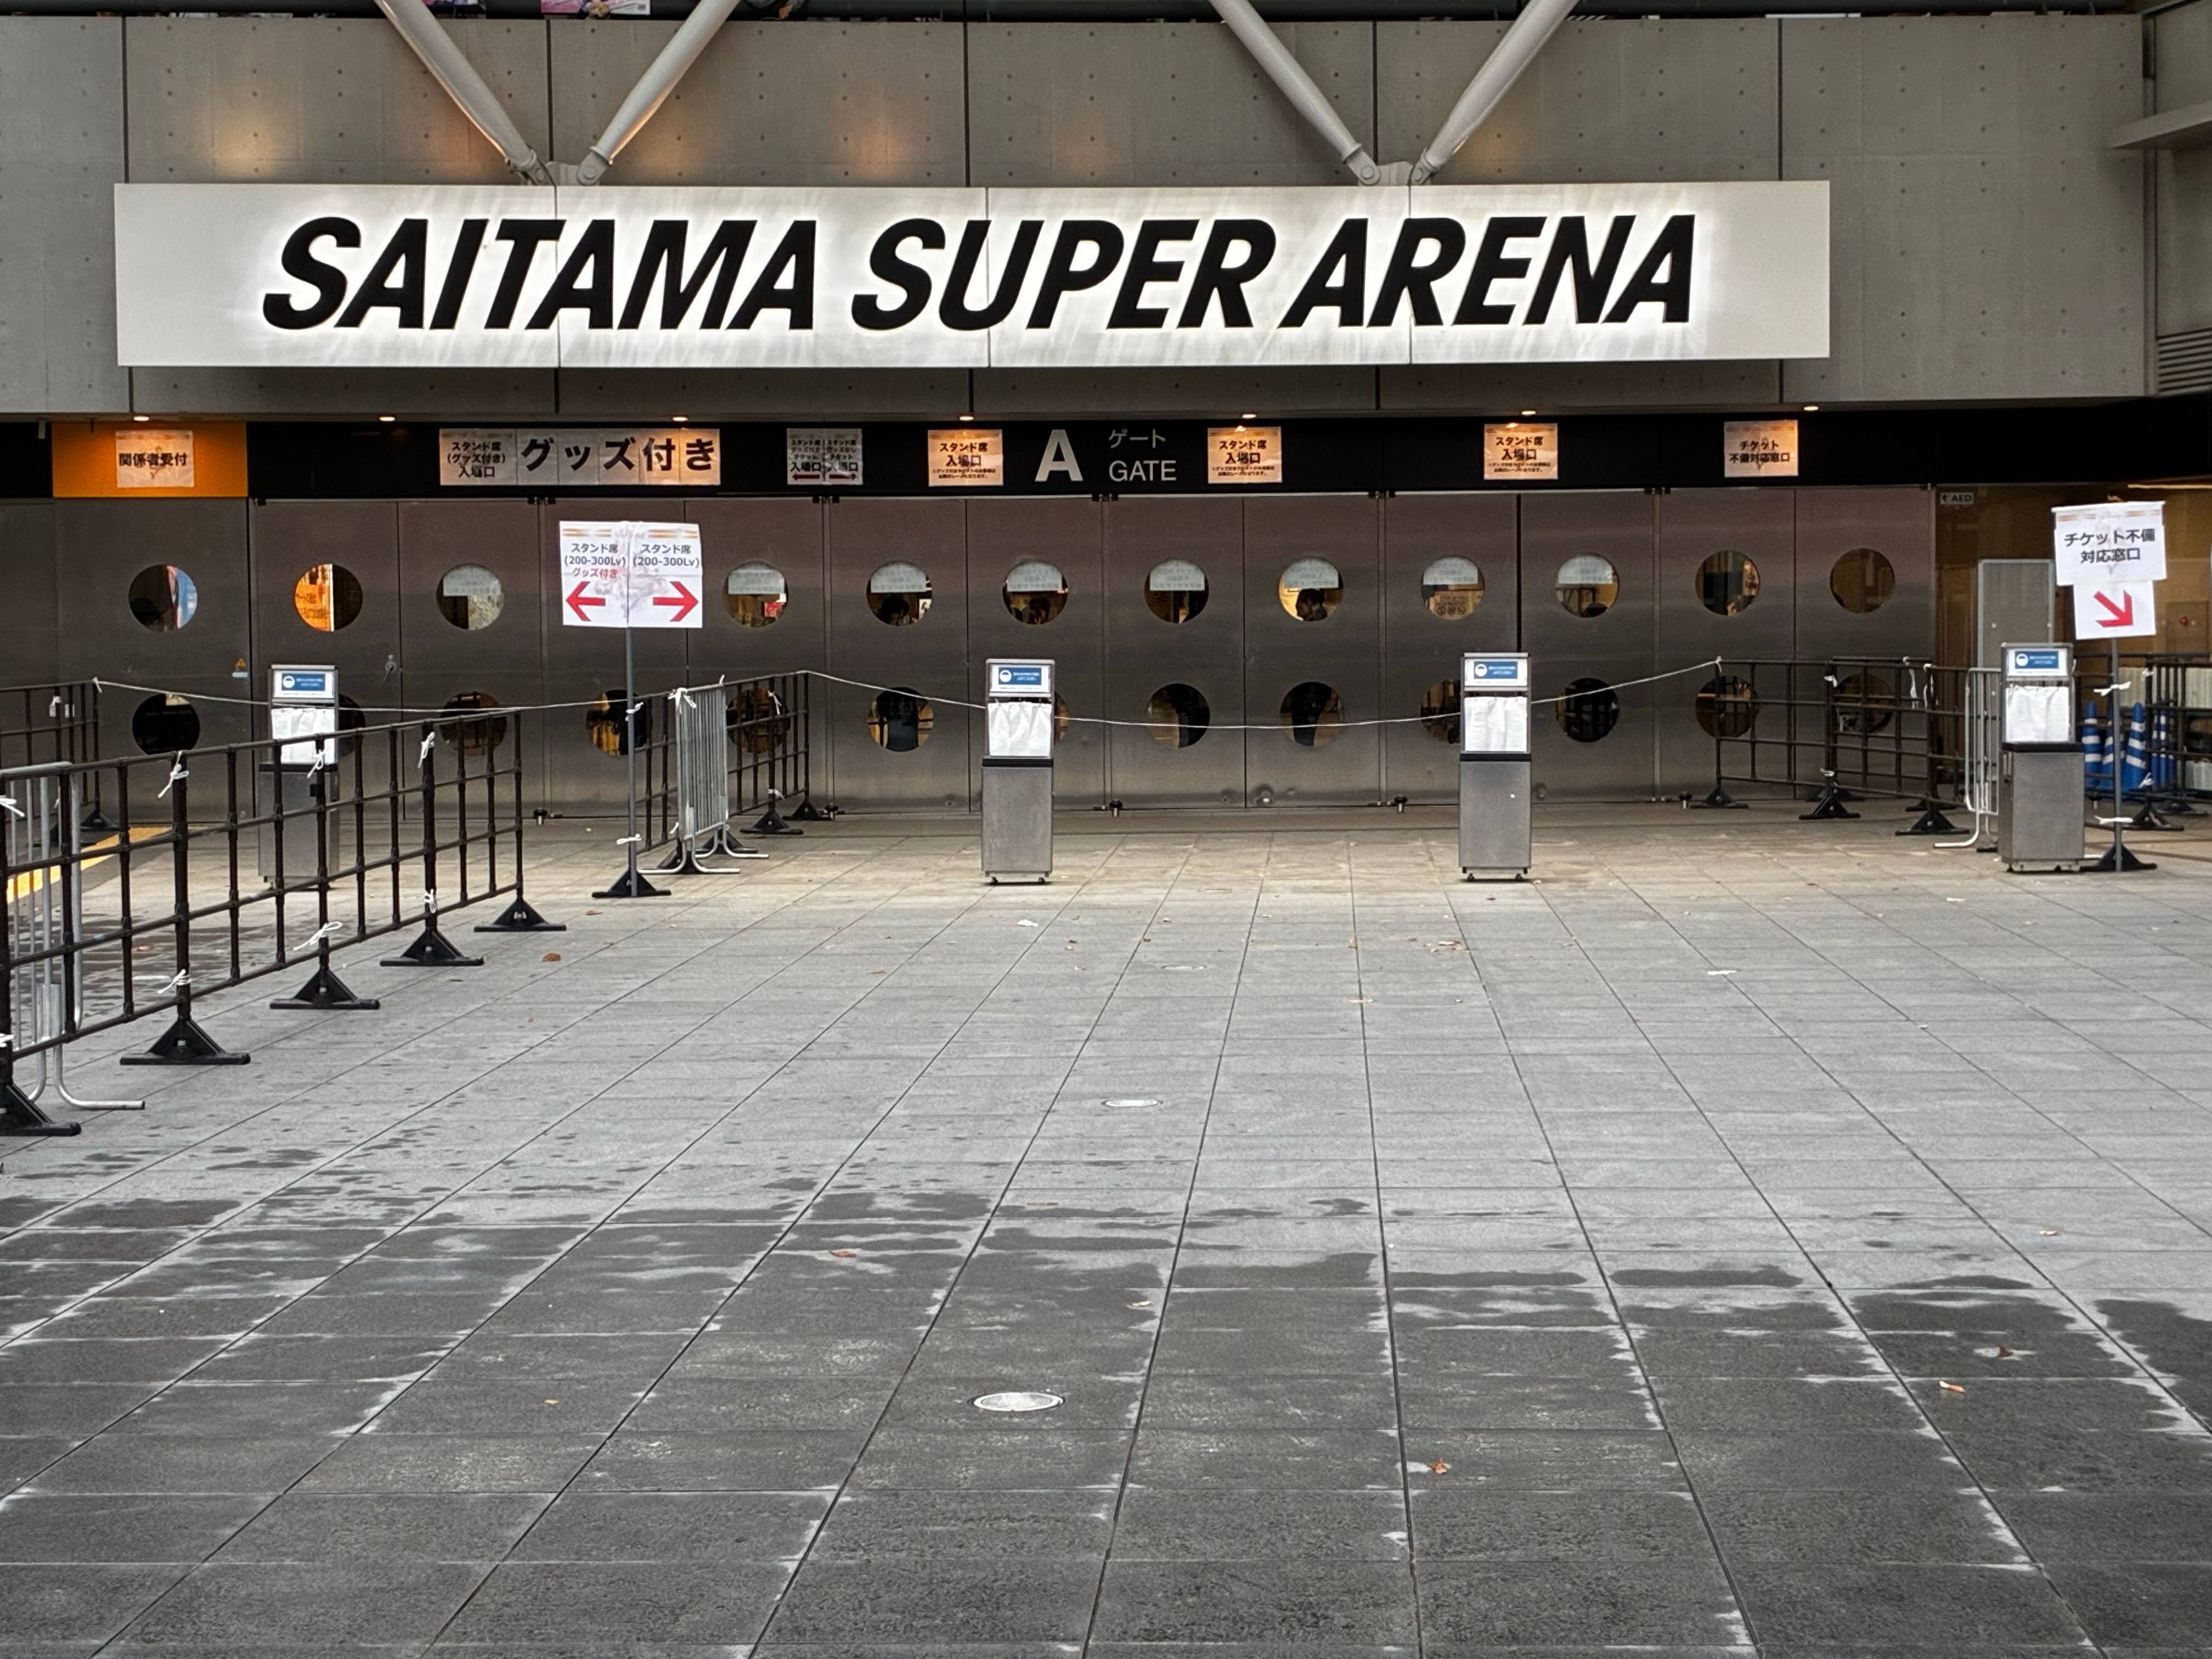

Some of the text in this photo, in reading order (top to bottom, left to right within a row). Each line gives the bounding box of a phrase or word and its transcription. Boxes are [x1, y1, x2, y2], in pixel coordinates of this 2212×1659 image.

[263, 215, 1694, 330] SAITAMA SUPER ARENA
[1109, 429, 1166, 449] ゲート
[1496, 436, 1544, 446] スタンド席
[452, 441, 501, 451] スタンド席
[940, 442, 988, 452] スタンド席
[1219, 440, 1267, 450] スタンド席
[1740, 440, 1779, 450] チケット
[448, 453, 505, 464] (グッズ付き)
[521, 437, 714, 471] グッズ付き
[1035, 429, 1084, 482] A
[1225, 453, 1260, 464] 入場口
[1502, 449, 1537, 460] 入場口
[119, 453, 187, 467] 関係者受付
[946, 455, 981, 466] 入場口
[458, 466, 495, 478] 入場口
[1109, 460, 1177, 482] GATE
[2064, 528, 2155, 547] チケット不備
[571, 543, 618, 554] スタンド席
[640, 544, 691, 554] スタンド席
[565, 555, 626, 567] (200-300Lv)
[2081, 548, 2141, 564] 対応窓口
[633, 556, 699, 568] (200-300Lv)
[573, 567, 618, 578] グッズ付き
